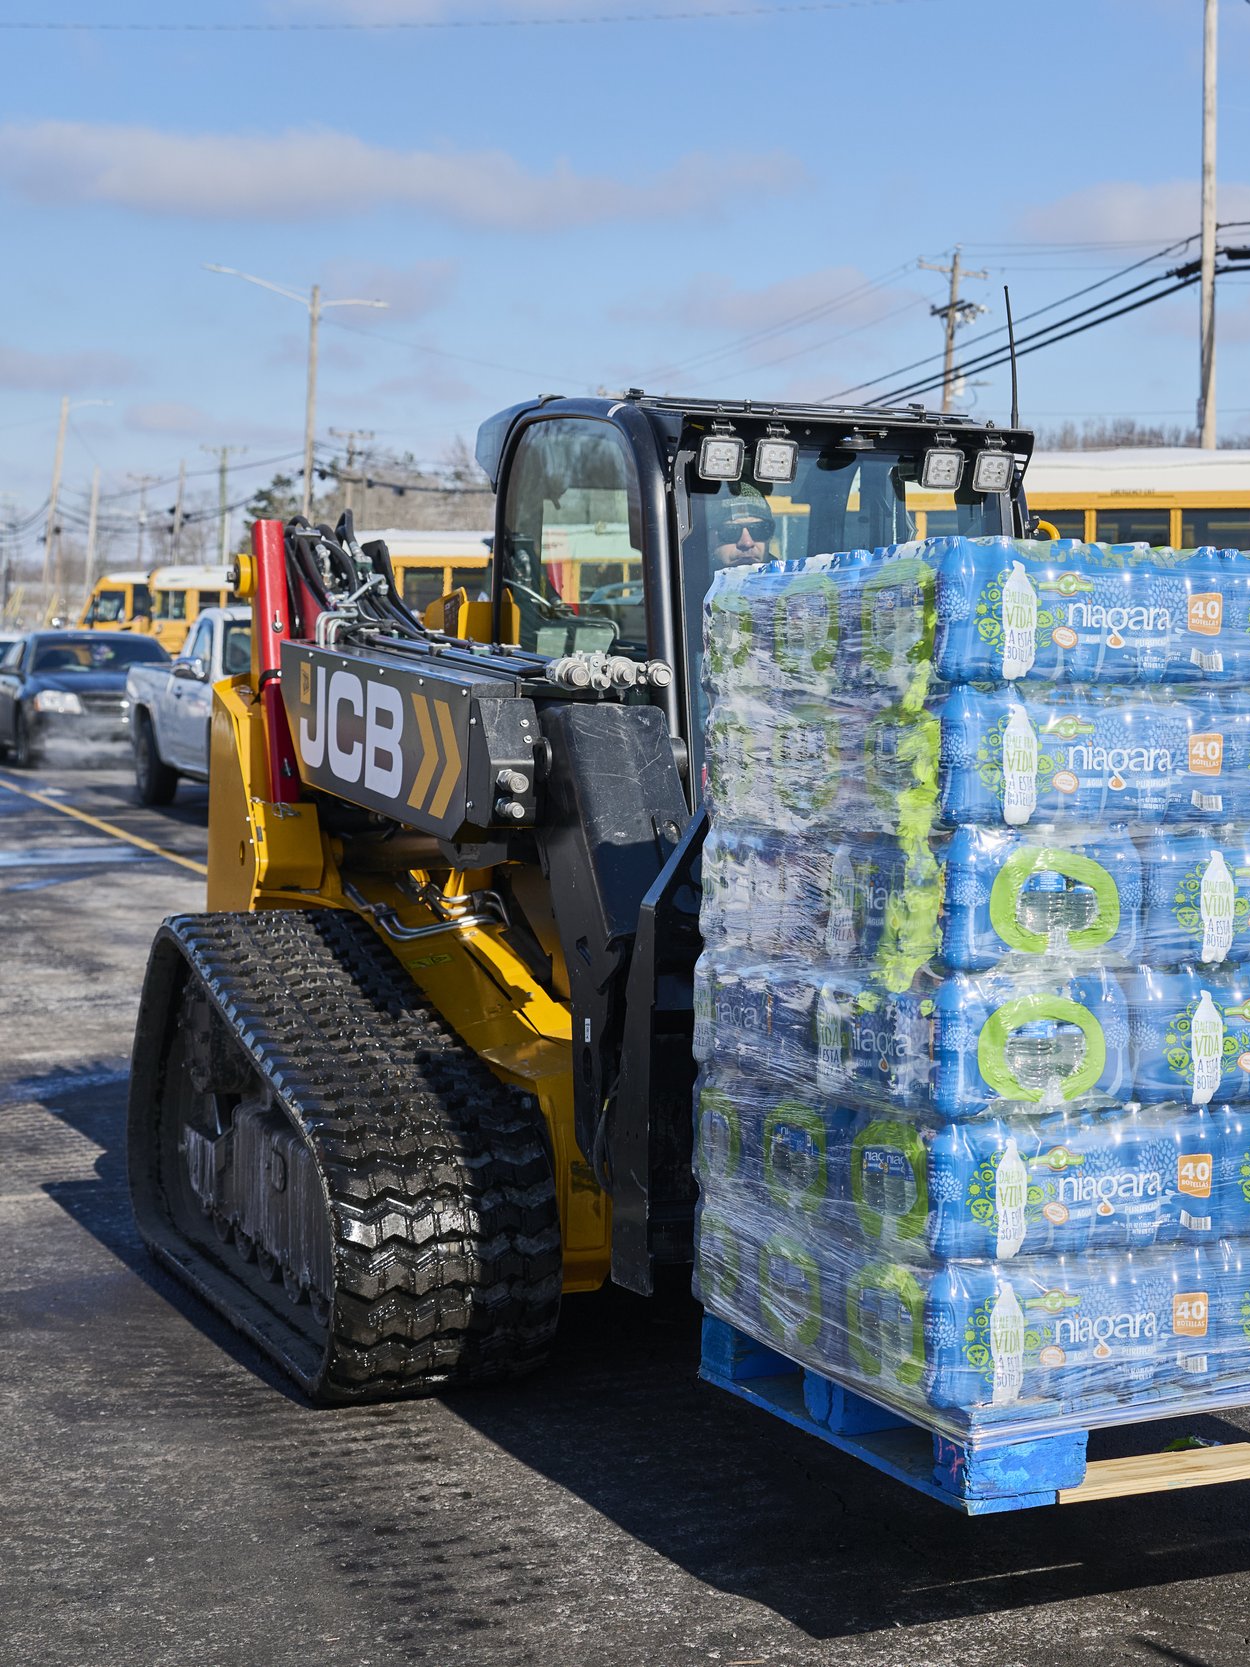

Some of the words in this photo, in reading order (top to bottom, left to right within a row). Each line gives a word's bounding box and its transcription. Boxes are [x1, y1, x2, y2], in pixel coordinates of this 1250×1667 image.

[1005, 604, 1033, 628] VIDA
[1191, 600, 1220, 619] 40
[1067, 600, 1172, 642] niagara
[1008, 629, 1015, 644] A
[300, 665, 404, 799] JCB
[1005, 750, 1034, 772] VIDA
[1191, 742, 1220, 760] 40
[1067, 740, 1173, 783] niagara
[1008, 774, 1015, 789] A
[1203, 895, 1232, 917] VIDA
[1208, 918, 1214, 932] A
[821, 1026, 840, 1047] IDA
[1194, 1035, 1220, 1057] VIDA
[1197, 1058, 1204, 1073] A
[1181, 1162, 1209, 1181] 40
[1058, 1172, 1162, 1210] niagara
[1181, 1179, 1209, 1188] BOTELLAS
[1002, 1209, 1008, 1225] A
[1176, 1300, 1205, 1320] 40
[1055, 1312, 1160, 1352] niagara
[1176, 1320, 1205, 1328] BOTELLAS
[992, 1329, 1020, 1354] VIDA
